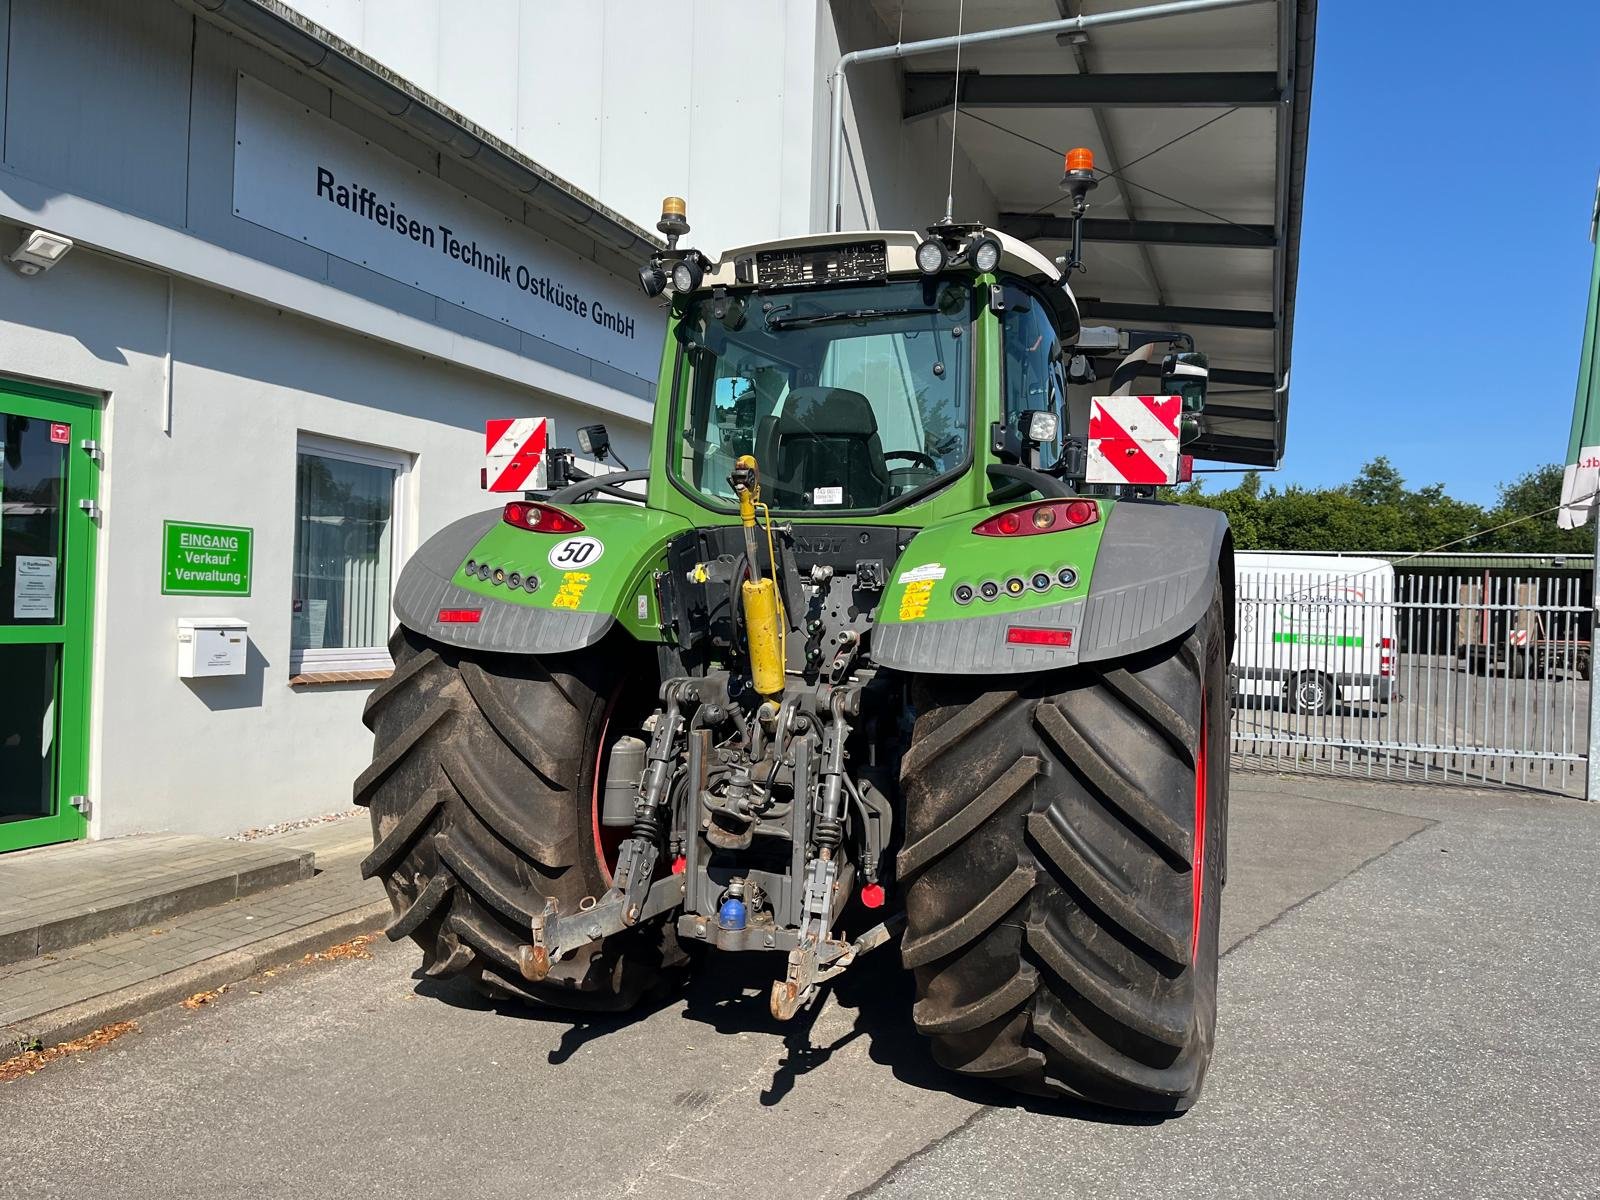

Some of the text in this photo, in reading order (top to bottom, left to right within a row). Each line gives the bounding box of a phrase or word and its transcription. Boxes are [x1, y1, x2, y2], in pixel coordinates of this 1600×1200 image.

[317, 166, 635, 339] Raiffeisen Technik Ostküste GmbH
[180, 533, 238, 549] EINGANG
[185, 550, 230, 565] Verkauf
[557, 541, 595, 563] 50
[175, 567, 240, 585] Verwaltung
